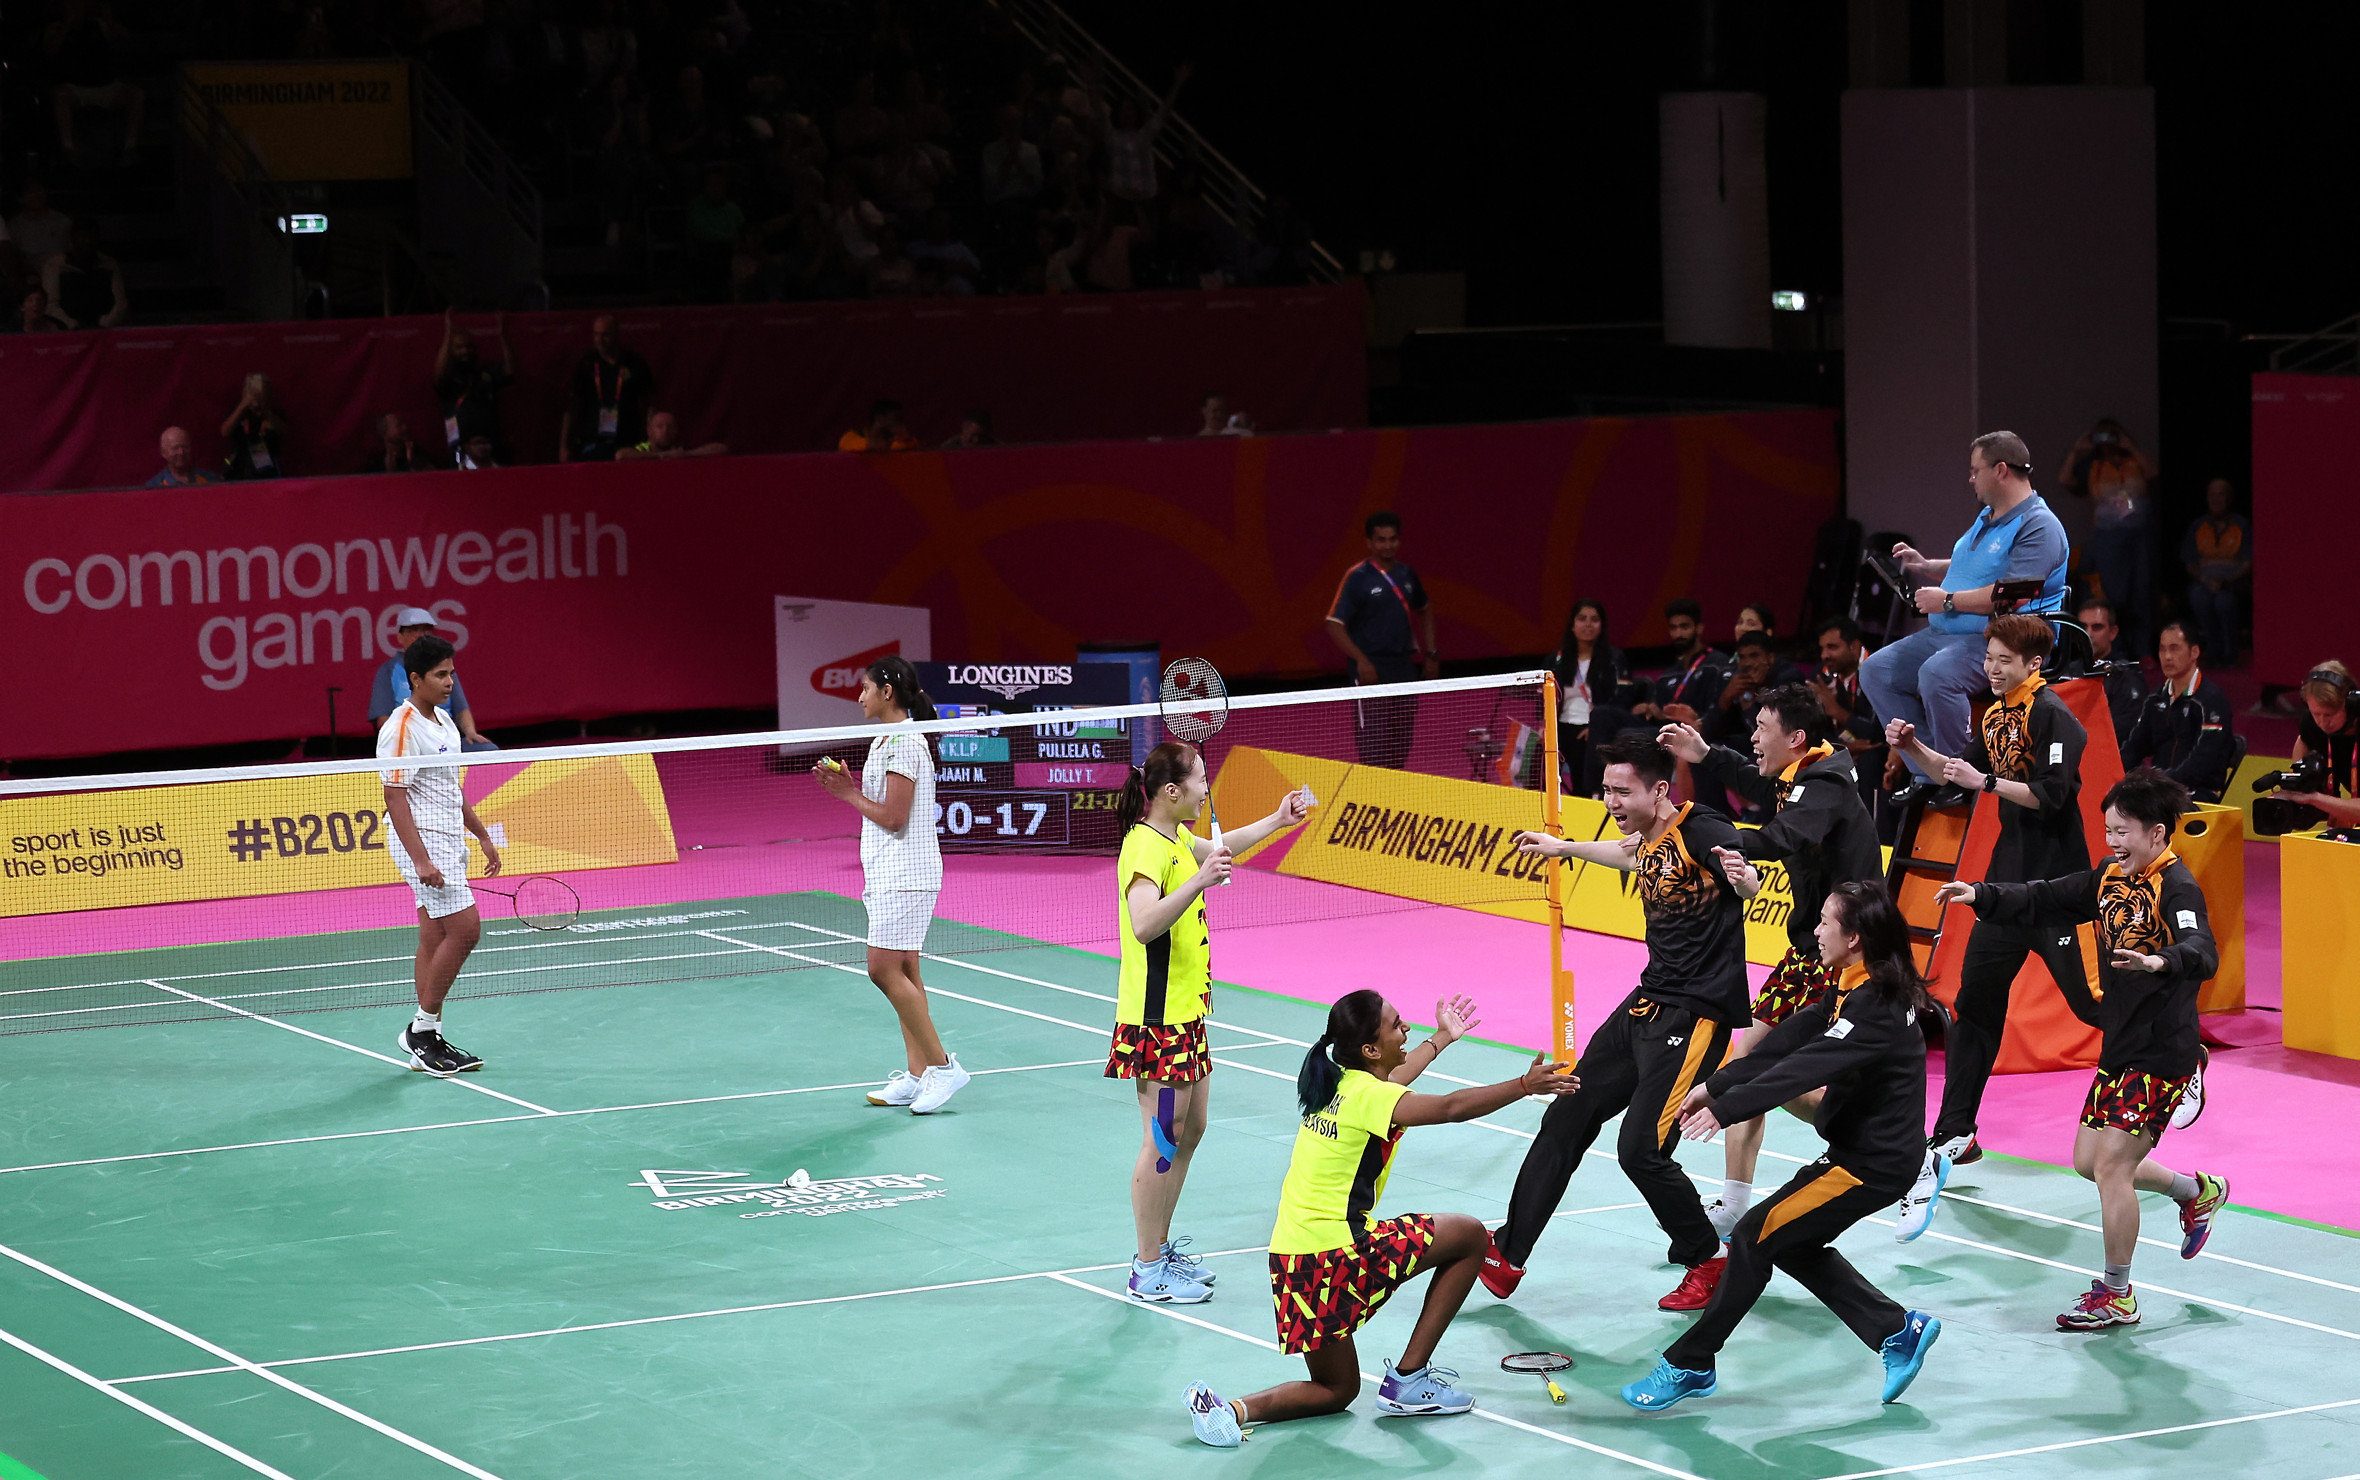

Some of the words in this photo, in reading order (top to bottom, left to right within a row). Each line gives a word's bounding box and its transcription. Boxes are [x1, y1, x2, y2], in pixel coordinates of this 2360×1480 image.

[201, 82, 334, 105] BIRMINGHAM
[341, 80, 391, 103] 2022
[24, 511, 629, 614] commonwealth
[199, 599, 470, 691] games
[821, 667, 868, 689] BW
[947, 665, 1073, 686] LONGINES
[1038, 743, 1090, 759] PULLELA
[1092, 743, 1106, 759] G.
[1047, 768, 1082, 783] JOLLY
[1085, 769, 1097, 783] T.
[12, 828, 80, 855] sport
[89, 827, 111, 849] is
[118, 821, 165, 848] just
[227, 809, 385, 862] #B202
[1327, 801, 1503, 873] BIRMINGHAM
[1494, 829, 1550, 885] 202
[3, 857, 47, 878] the
[54, 847, 184, 877] beginning
[1565, 1020, 1574, 1050] YONEX
[1302, 1114, 1338, 1140] LAYSIA
[650, 1173, 945, 1211] BIRMINGHAM
[759, 1189, 882, 1209] 2022
